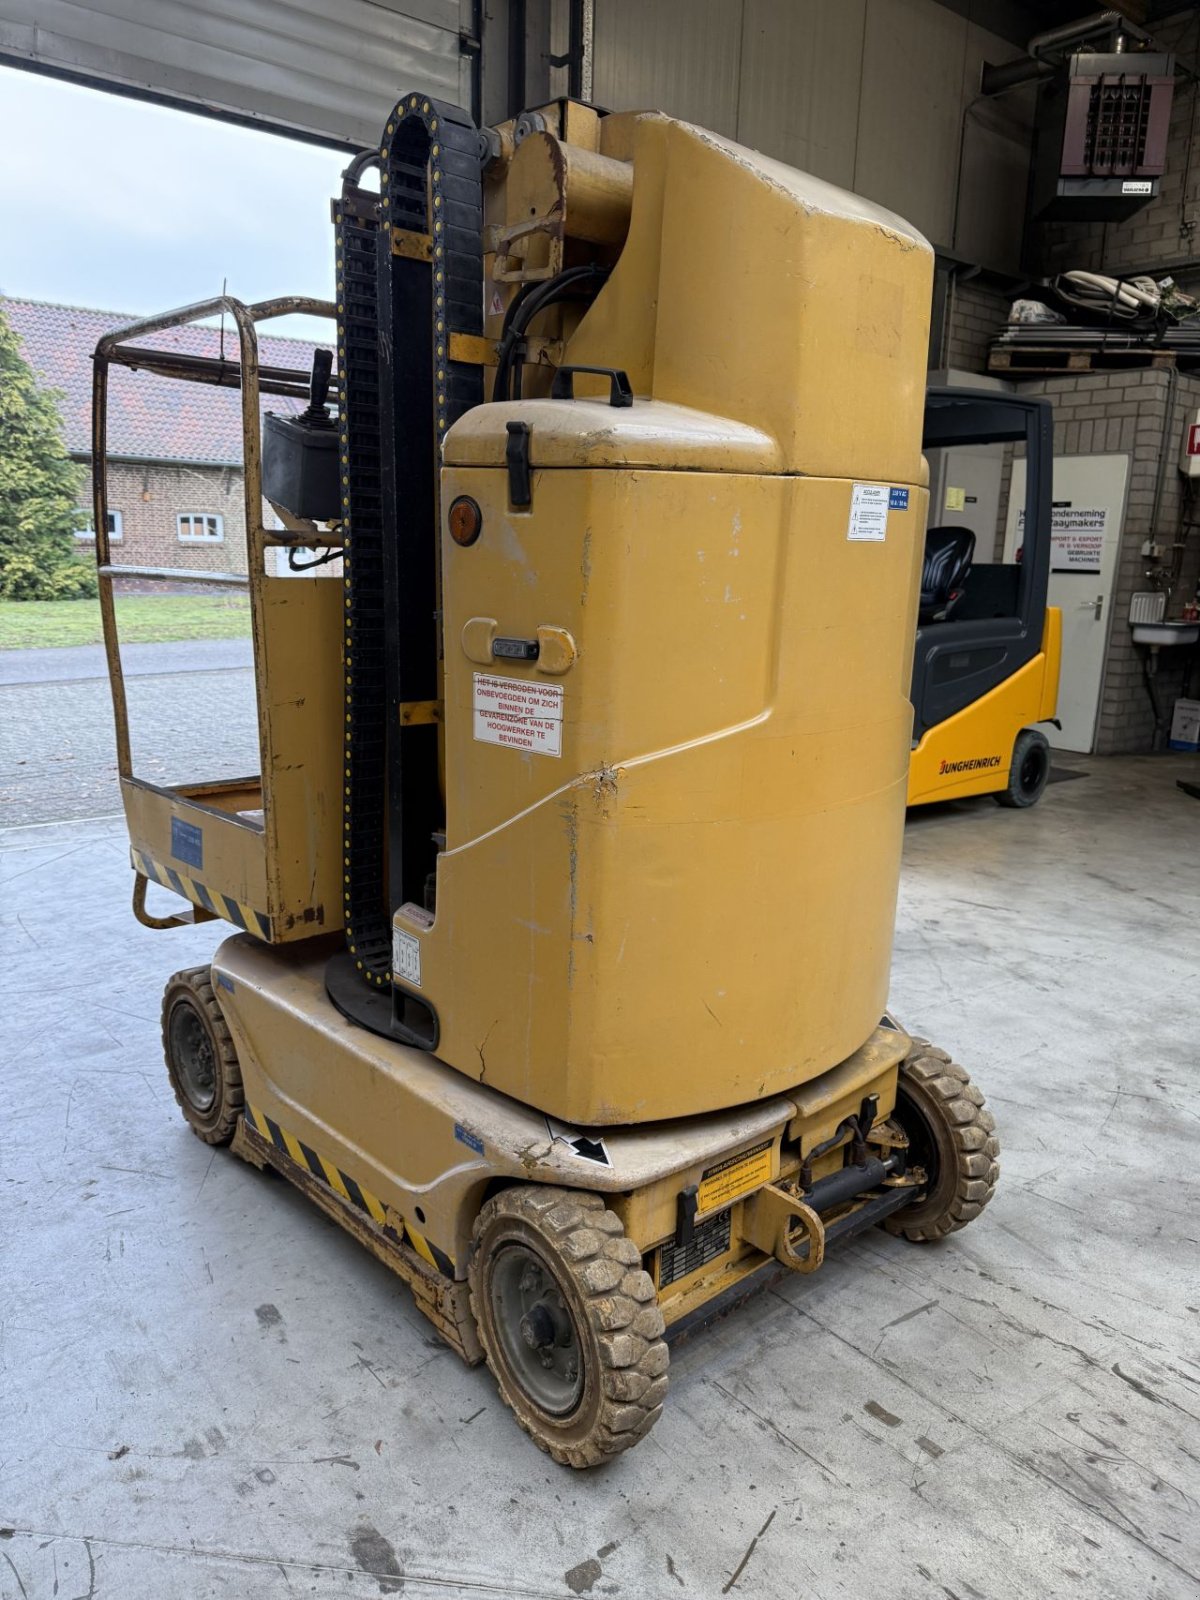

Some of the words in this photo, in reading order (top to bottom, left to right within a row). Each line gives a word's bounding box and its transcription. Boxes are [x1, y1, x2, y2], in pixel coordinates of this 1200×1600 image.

[477, 678, 490, 687] HET
[491, 680, 498, 688] IS
[500, 681, 536, 694] VERBODEN
[538, 688, 559, 697] VOOR
[476, 688, 527, 704] ONBEVOEGDEN
[528, 697, 540, 705] OM
[541, 699, 559, 708] ZICH
[498, 702, 523, 714] BINNEN
[524, 707, 535, 715] DE
[479, 709, 528, 726] GEVARENZONE
[529, 719, 543, 729] VAN
[544, 722, 555, 731] DE
[487, 721, 535, 737] HOOGWERKER
[536, 730, 546, 739] TE
[498, 733, 533, 747] BEVINDEN
[939, 756, 1002, 775] JUNGHEINRICH
